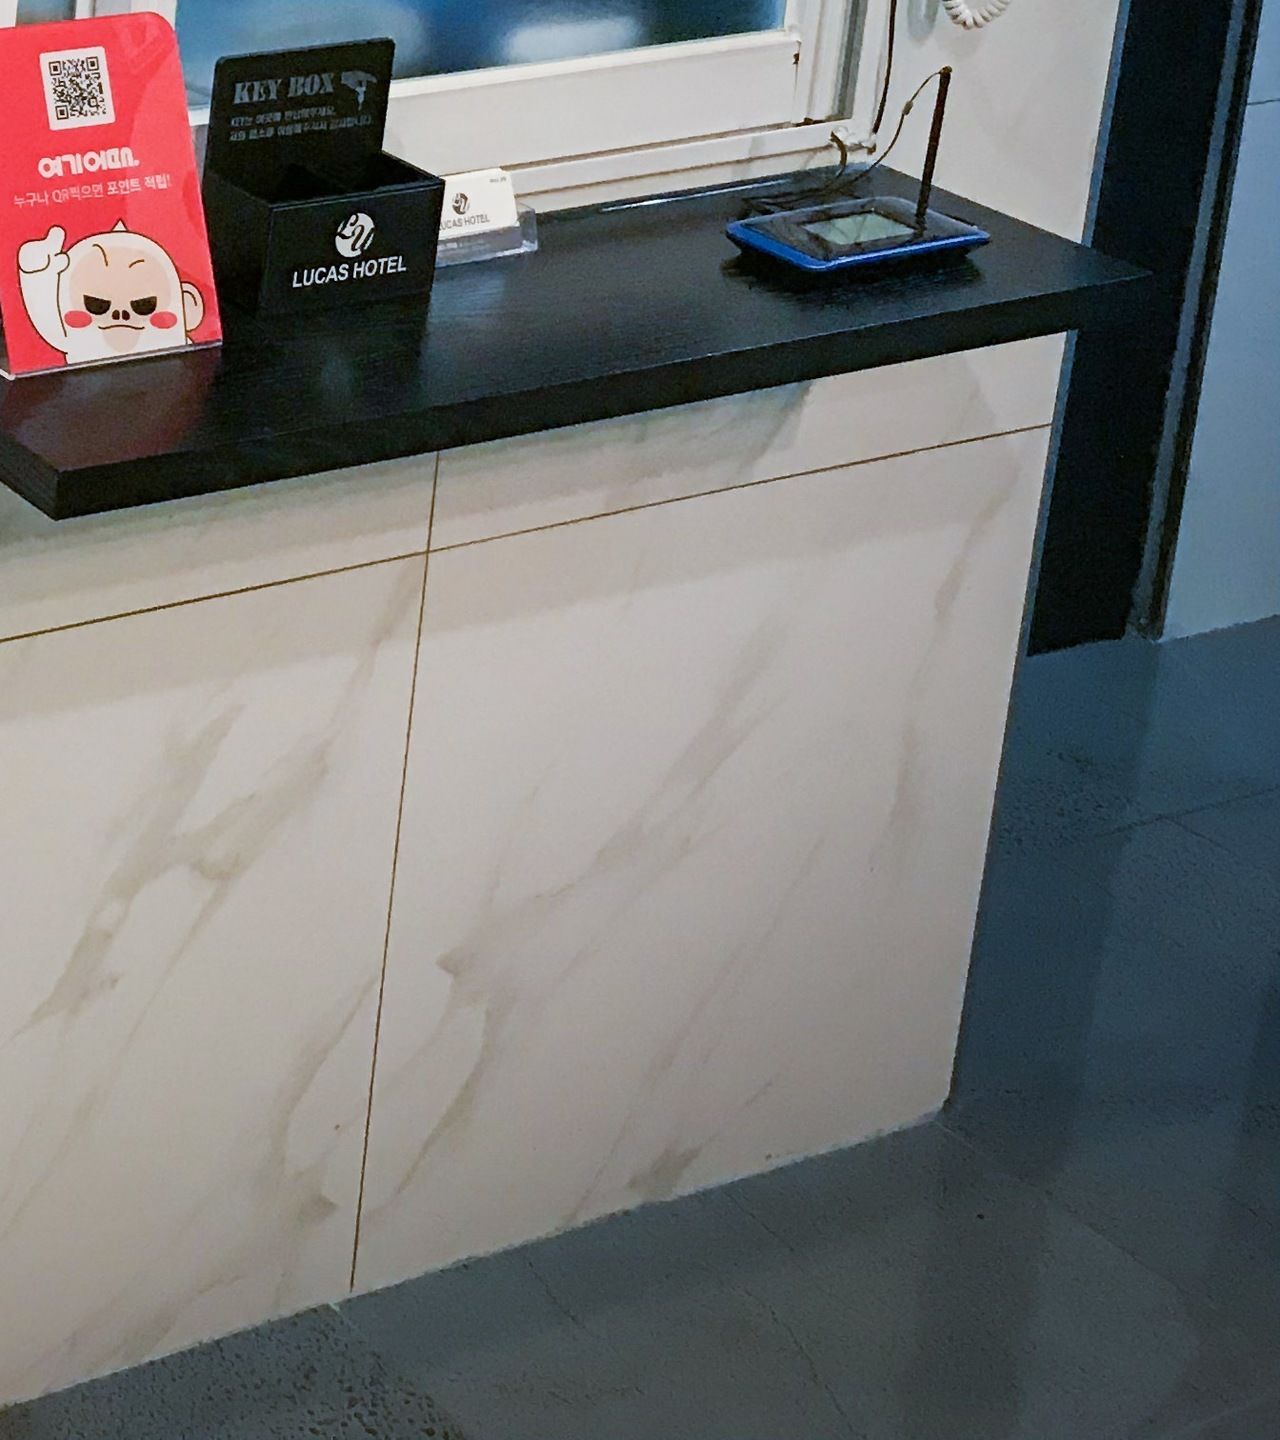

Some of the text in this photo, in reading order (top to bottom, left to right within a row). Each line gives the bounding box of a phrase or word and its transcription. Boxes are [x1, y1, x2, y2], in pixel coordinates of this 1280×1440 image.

[233, 71, 335, 105] KEY BOX
[107, 177, 141, 196] 포인트
[292, 255, 408, 289] LUCAS HOTEL
